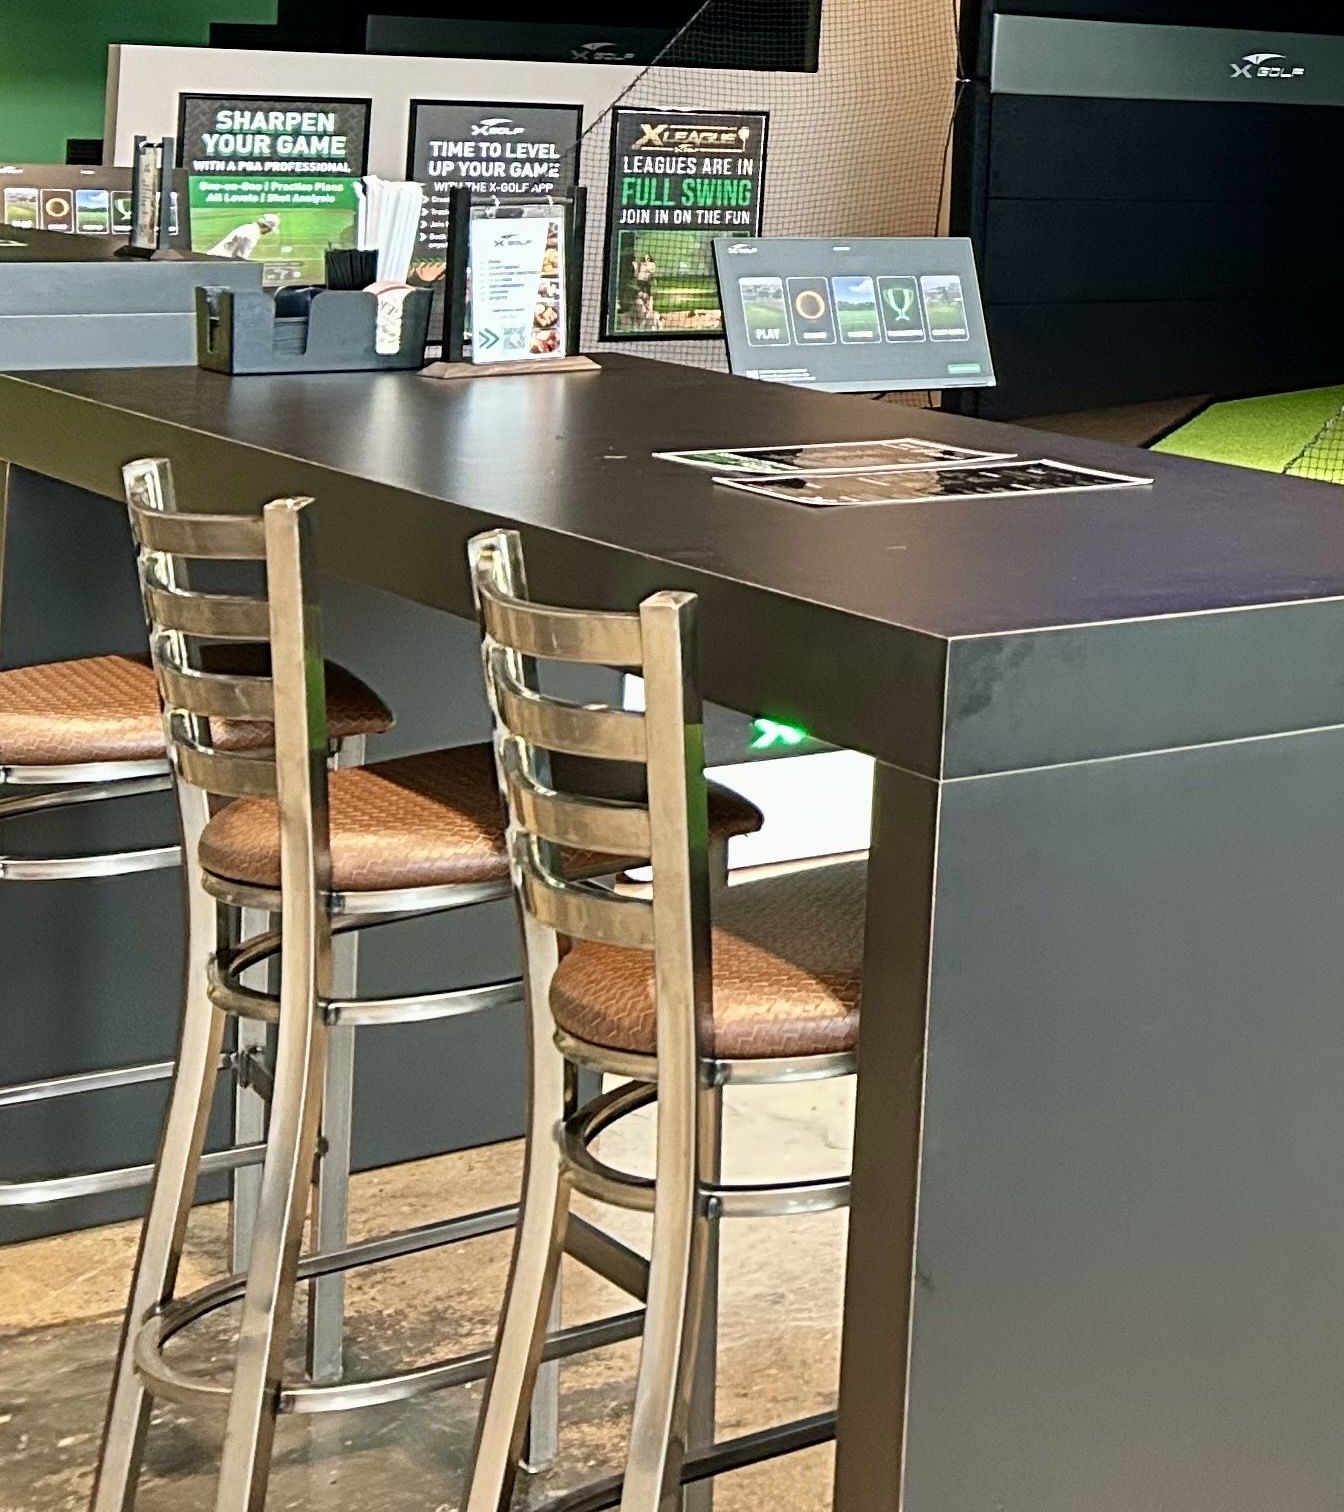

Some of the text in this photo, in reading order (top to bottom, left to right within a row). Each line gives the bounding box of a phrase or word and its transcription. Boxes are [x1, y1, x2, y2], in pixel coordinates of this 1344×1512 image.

[1230, 63, 1305, 79] X GOLF
[215, 109, 335, 134] SHARPEN
[471, 124, 526, 136] X GOLF
[202, 133, 347, 158] YOUR GAME
[429, 141, 561, 159] TIME TO LEVEL
[193, 160, 225, 172] WITH
[226, 160, 236, 172] A
[264, 161, 352, 173] PROFESSIONAL
[428, 160, 560, 178] UP YOUR GAME
[623, 156, 754, 176] LEAGUES ARE IN
[465, 182, 487, 193] THE
[489, 182, 530, 193] X-GOLF
[531, 183, 554, 193] APP
[621, 177, 752, 207] FULL SWING
[619, 209, 750, 225] JOIN IN ON THE FUN
